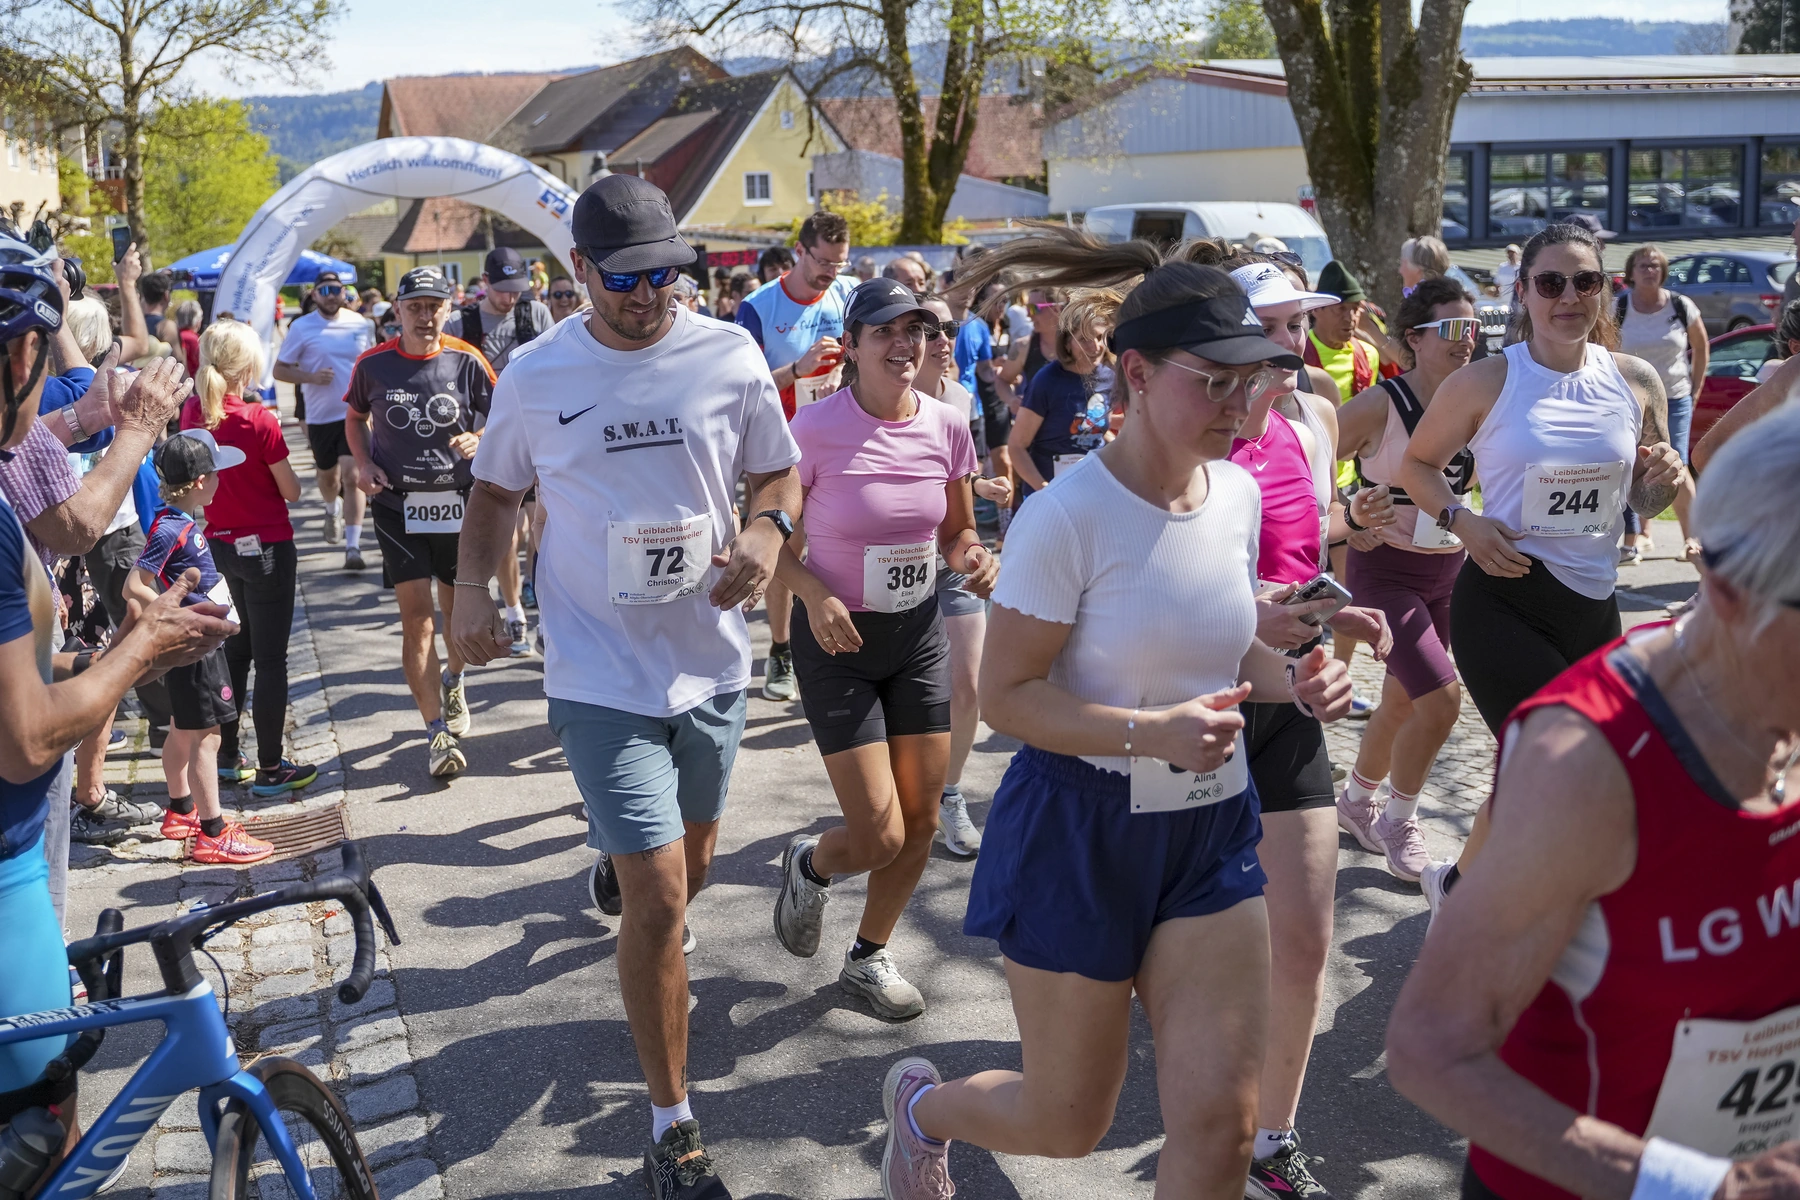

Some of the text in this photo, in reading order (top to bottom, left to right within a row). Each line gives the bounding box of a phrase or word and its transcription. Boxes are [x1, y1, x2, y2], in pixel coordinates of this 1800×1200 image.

[346, 155, 503, 183] Herzlich willkommen!
[39, 304, 59, 324] ABUS
[386, 392, 419, 403] trophy
[603, 417, 683, 442] S.W.A.T.
[434, 473, 454, 484] AOK
[1553, 467, 1601, 476] Leiblachlauf
[1557, 474, 1611, 484] Hergensweiler
[1547, 489, 1599, 515] 244
[406, 503, 463, 521] 20920
[638, 523, 692, 535] Leiblachlauf
[1582, 523, 1600, 533] AOK
[622, 530, 703, 545] TSV Hergensweiler
[890, 545, 930, 555] Leiblachlauf
[646, 546, 684, 577] 72
[647, 576, 684, 587] Christoph
[887, 562, 928, 590] 384
[675, 586, 695, 598] AOK
[895, 600, 911, 609] AOK
[1193, 772, 1217, 784] Alina
[1185, 787, 1212, 802] AOK
[1658, 906, 1744, 963] LG
[1707, 1049, 1743, 1063] TSV
[323, 1100, 354, 1155] SWISS
[1738, 1112, 1794, 1134] Irmgard
[1727, 1136, 1769, 1158] AOK
